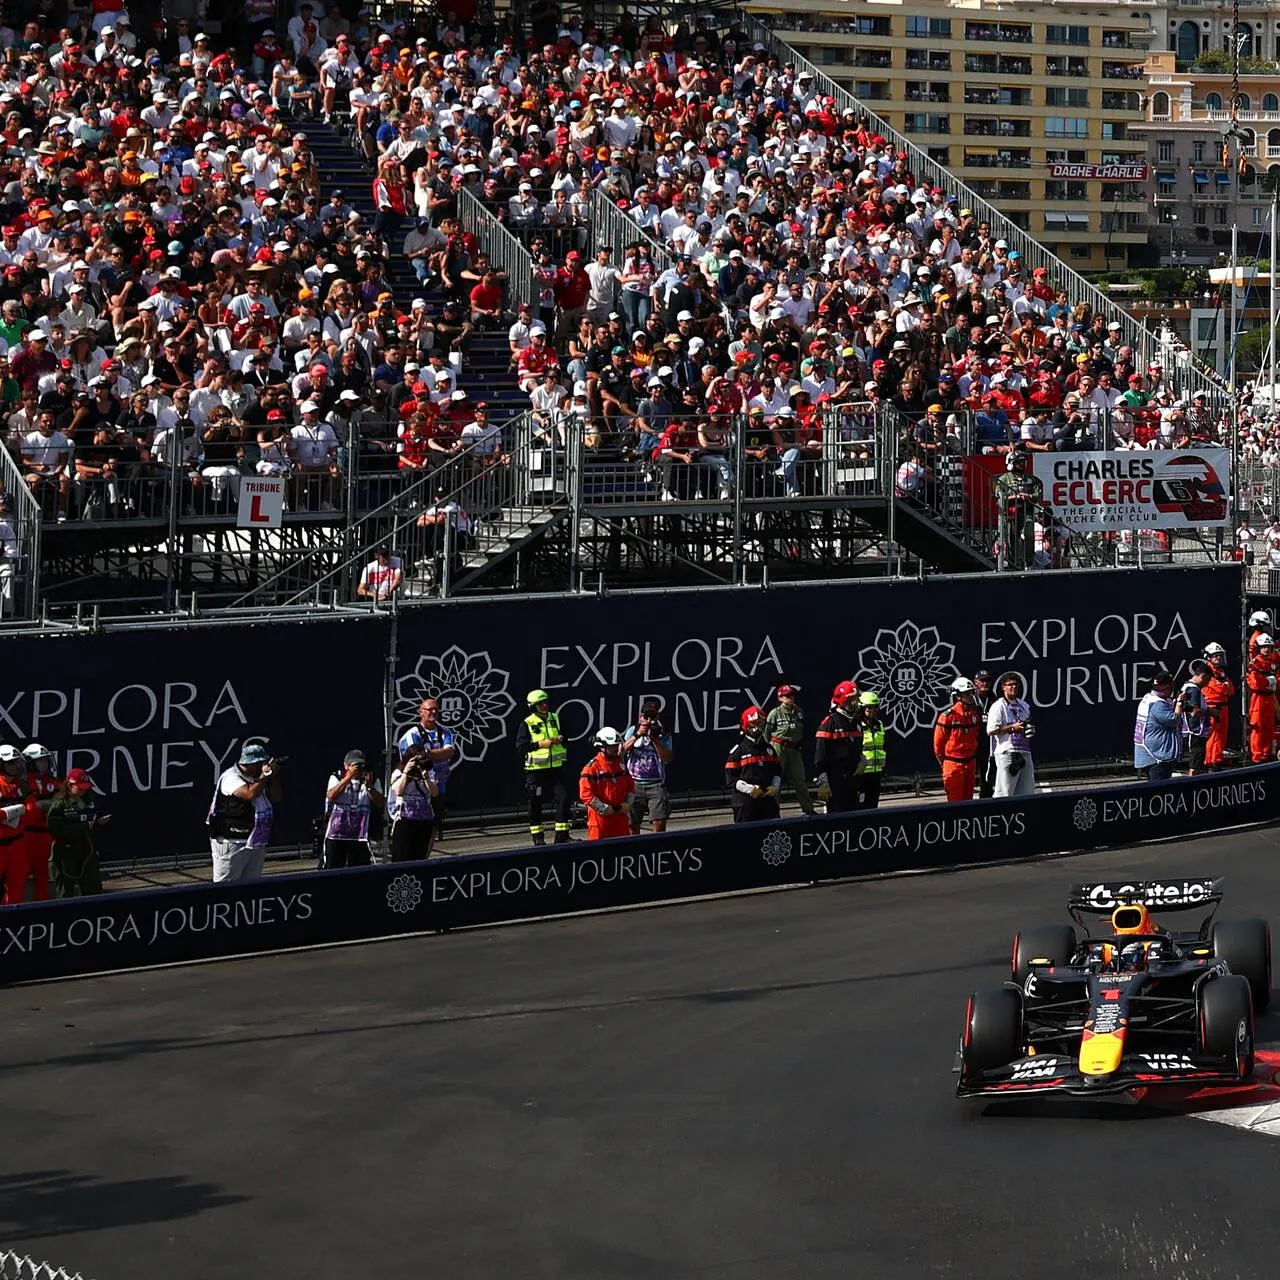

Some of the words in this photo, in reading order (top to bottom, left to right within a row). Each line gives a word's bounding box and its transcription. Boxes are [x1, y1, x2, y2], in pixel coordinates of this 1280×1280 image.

[1053, 165, 1093, 177] DAGHE
[1095, 167, 1144, 178] CHARLIE
[1053, 458, 1155, 481] CHARLES
[246, 482, 281, 493] TRIBUNE
[250, 495, 270, 522] L
[1062, 507, 1084, 516] THE
[1090, 505, 1143, 515] OFFICIAL
[1103, 514, 1124, 523] FAN
[1129, 513, 1158, 522] CLUB
[981, 612, 1193, 661] EXPLORA
[541, 634, 783, 689] EXPLORA
[1103, 794, 1188, 823] EXPLORA
[1191, 780, 1267, 811] JOURNEYS
[799, 823, 909, 858] EXPLORA
[914, 812, 1027, 853] JOURNEYS
[431, 865, 561, 903] EXPLORA
[567, 846, 704, 896] JOURNEYS
[0, 913, 140, 955] XPLORA
[149, 892, 313, 945] JOURNEYS
[1139, 1053, 1197, 1070] VISA
